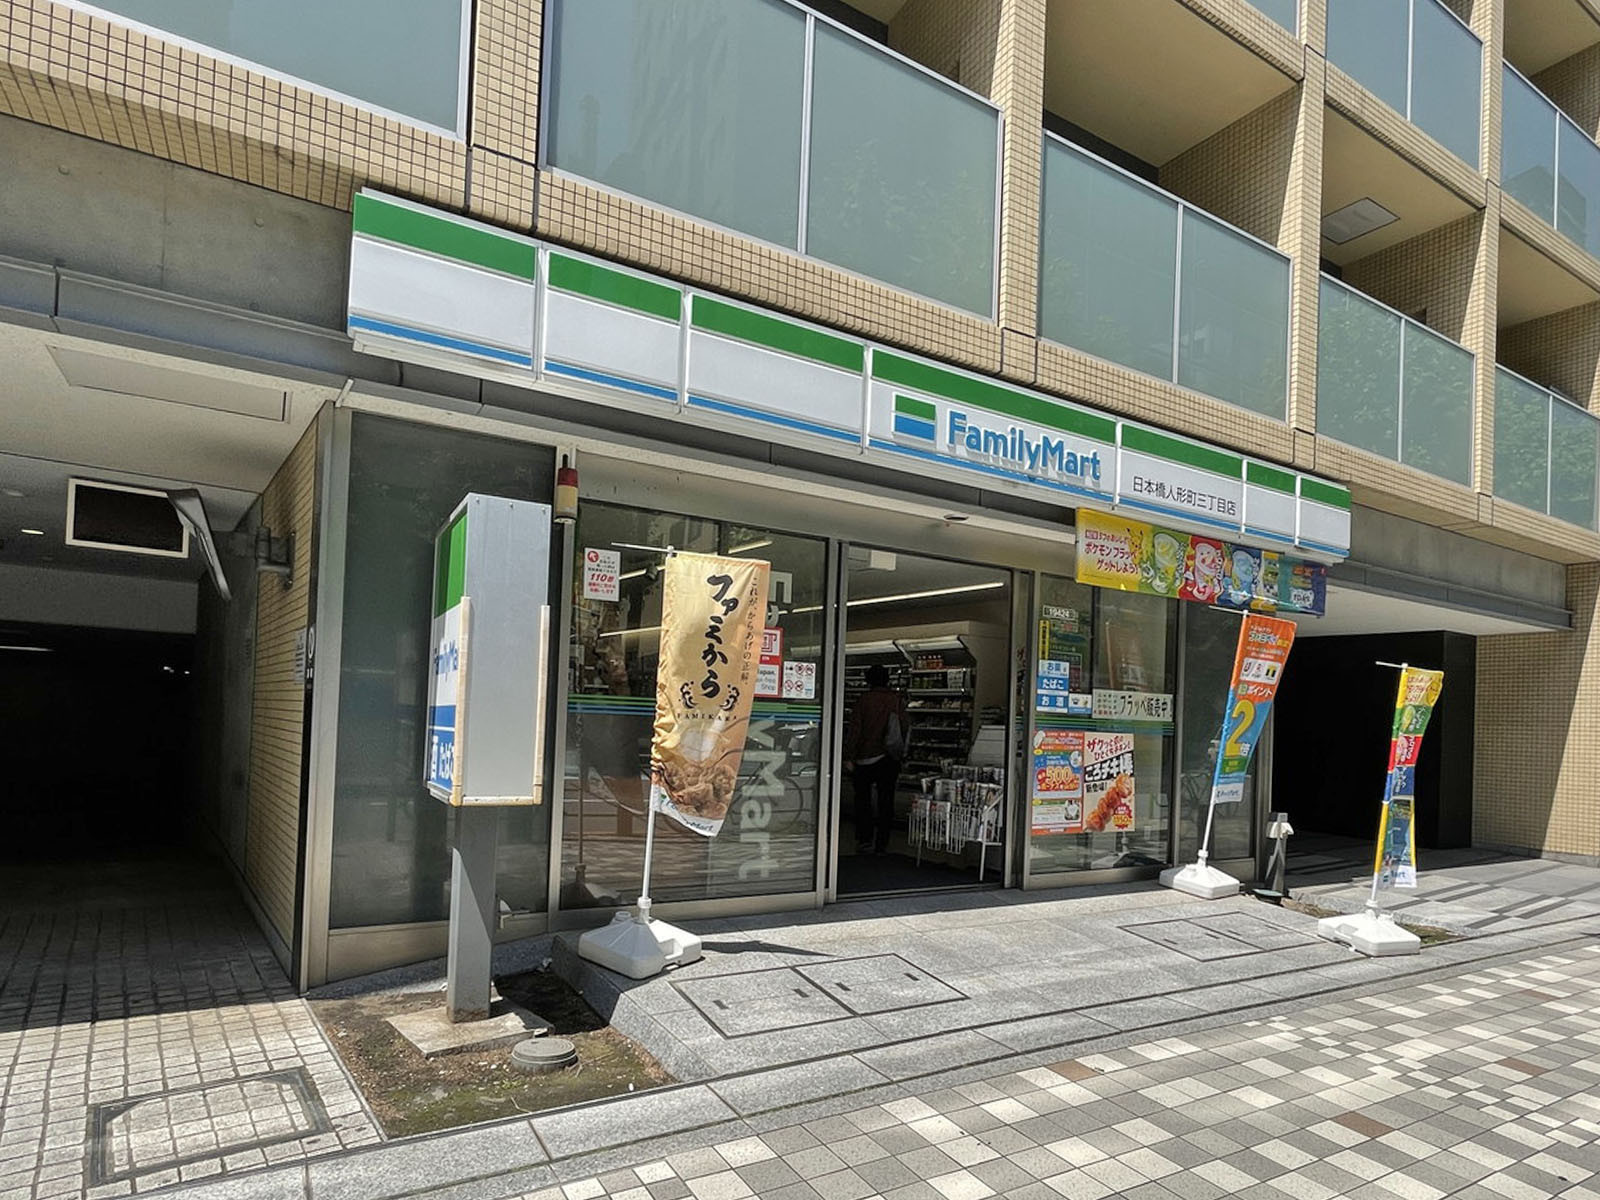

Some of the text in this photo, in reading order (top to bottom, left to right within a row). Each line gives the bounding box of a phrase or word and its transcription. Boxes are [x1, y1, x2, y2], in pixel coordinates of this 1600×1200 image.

[948, 410, 1101, 481] FamilyMart
[1132, 476, 1237, 516] 日本橋人形町三丁目店
[701, 574, 740, 698] ファミから
[1042, 679, 1065, 690] たばこ
